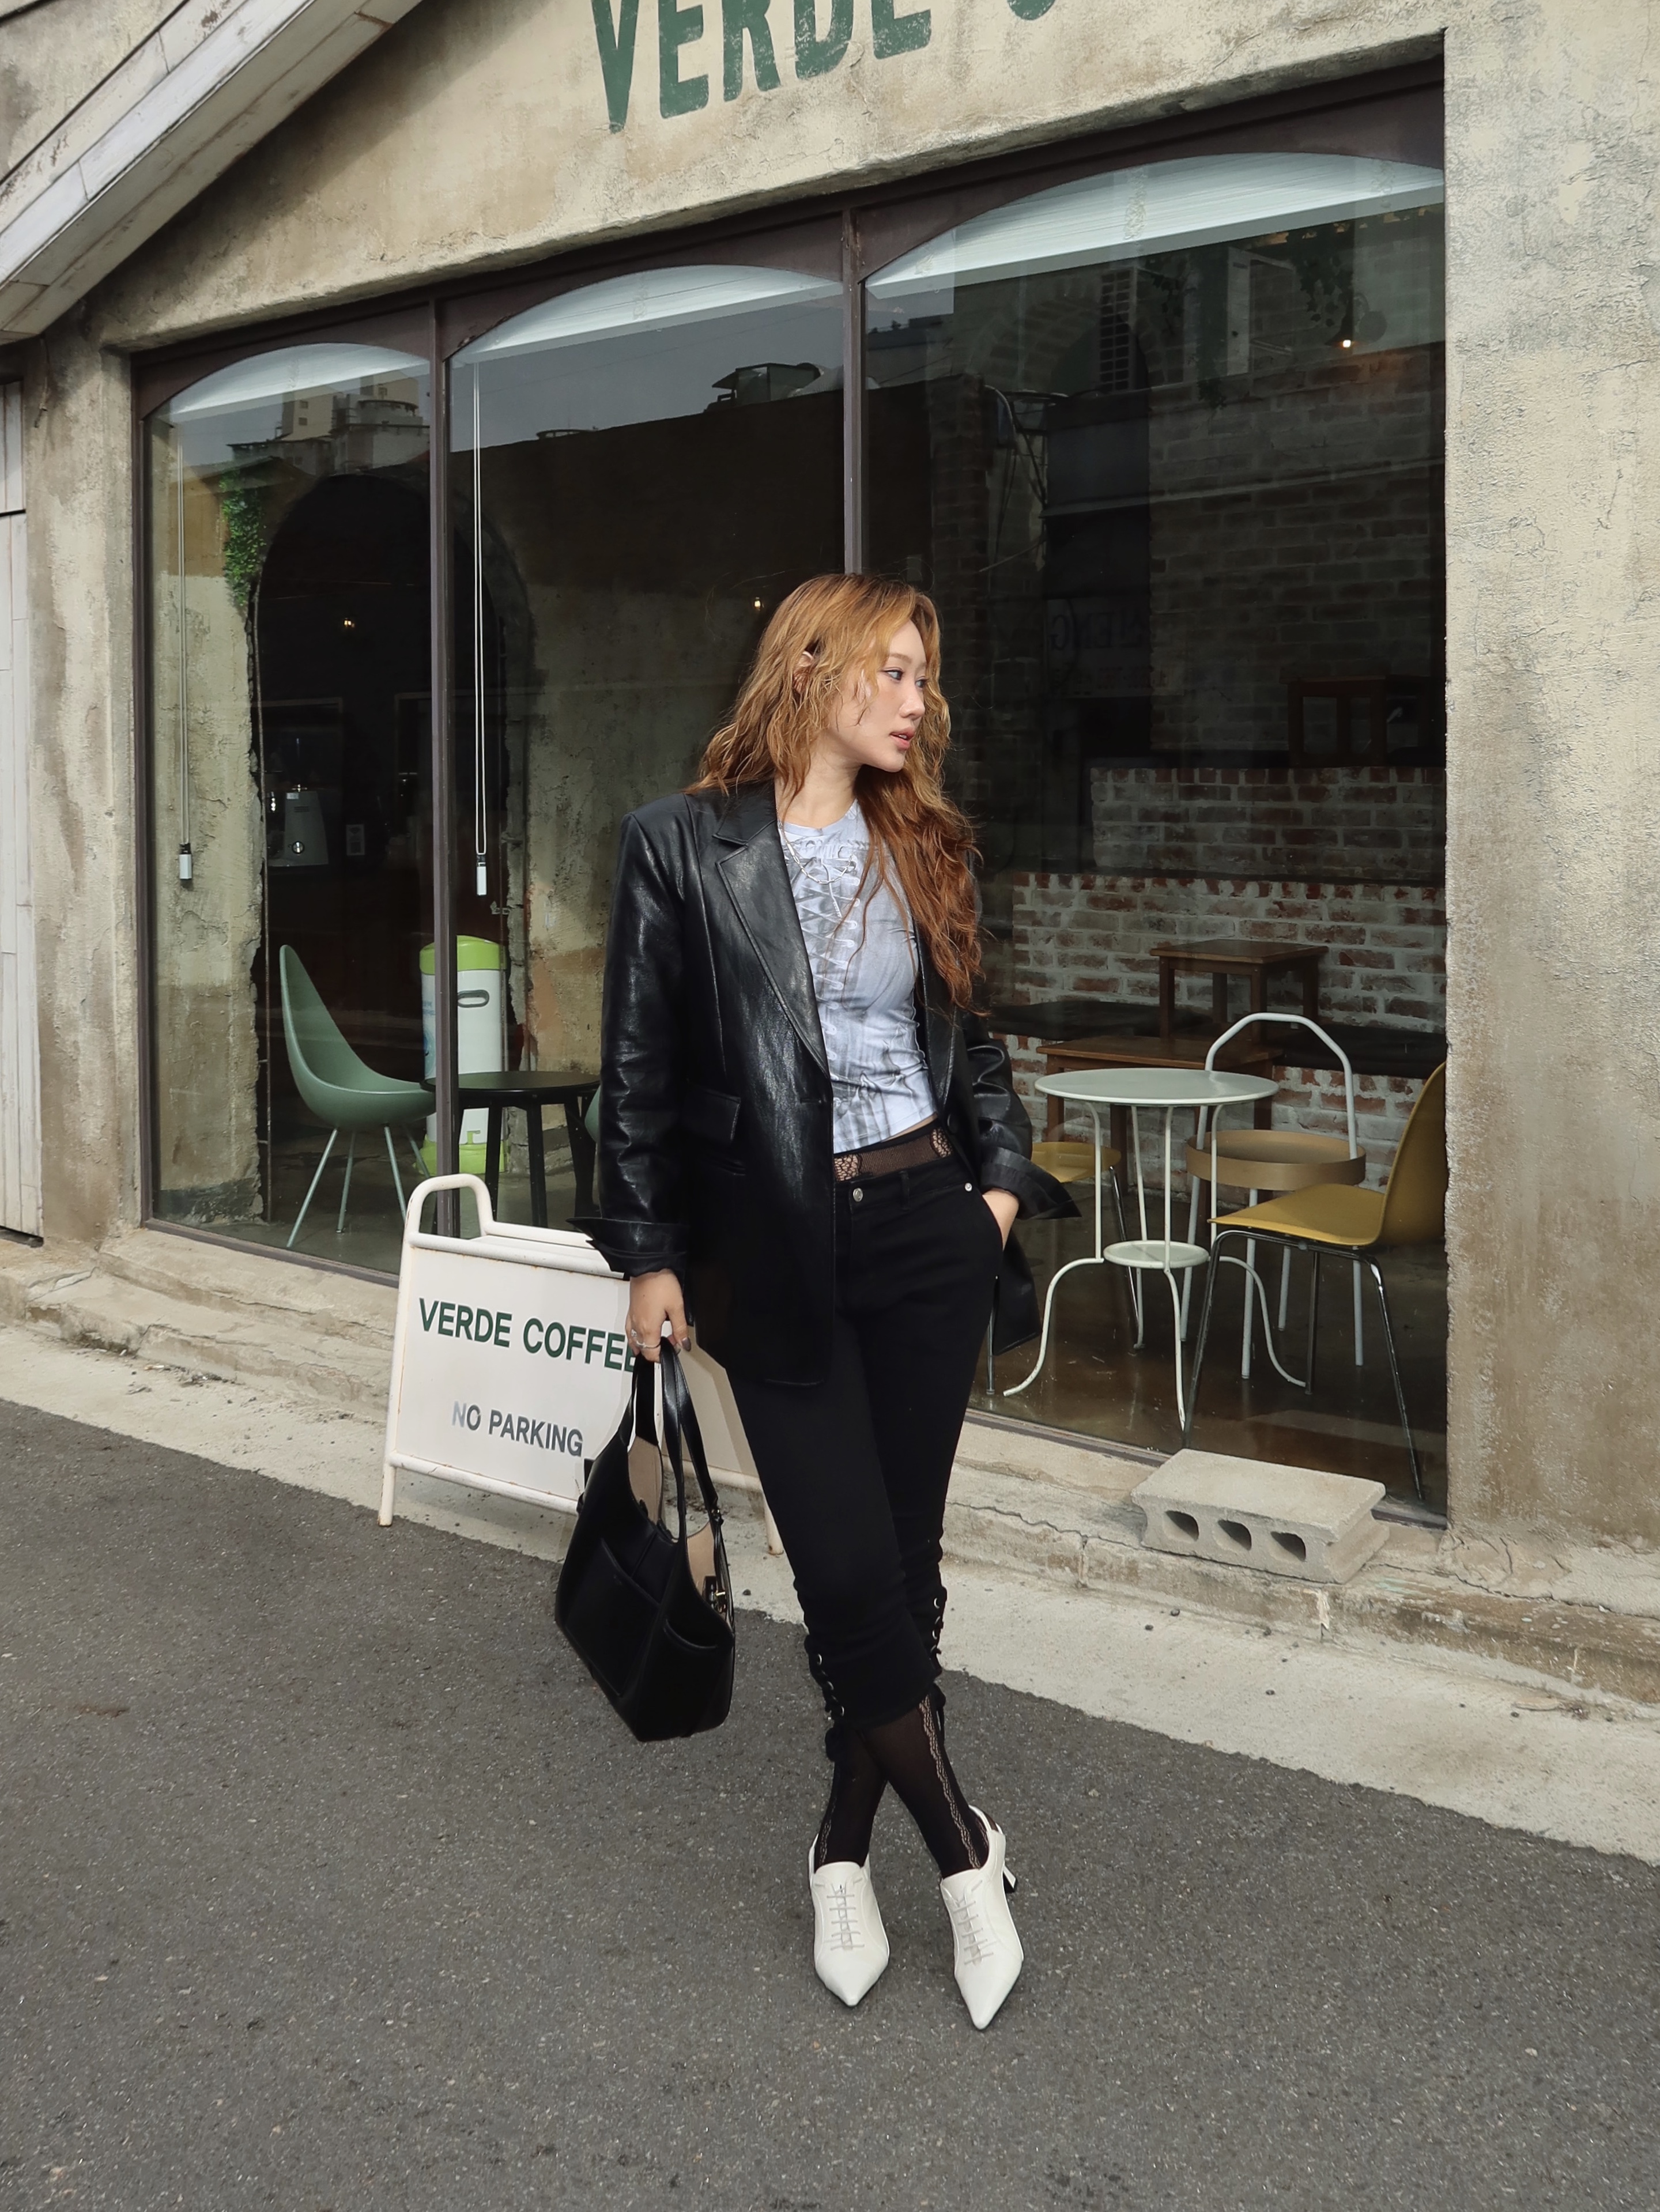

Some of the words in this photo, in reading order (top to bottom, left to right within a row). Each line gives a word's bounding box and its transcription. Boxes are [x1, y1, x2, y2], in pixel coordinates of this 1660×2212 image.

[419, 1298, 512, 1347] VERDE
[451, 1401, 481, 1430] NO
[488, 1410, 583, 1457] PARKING
